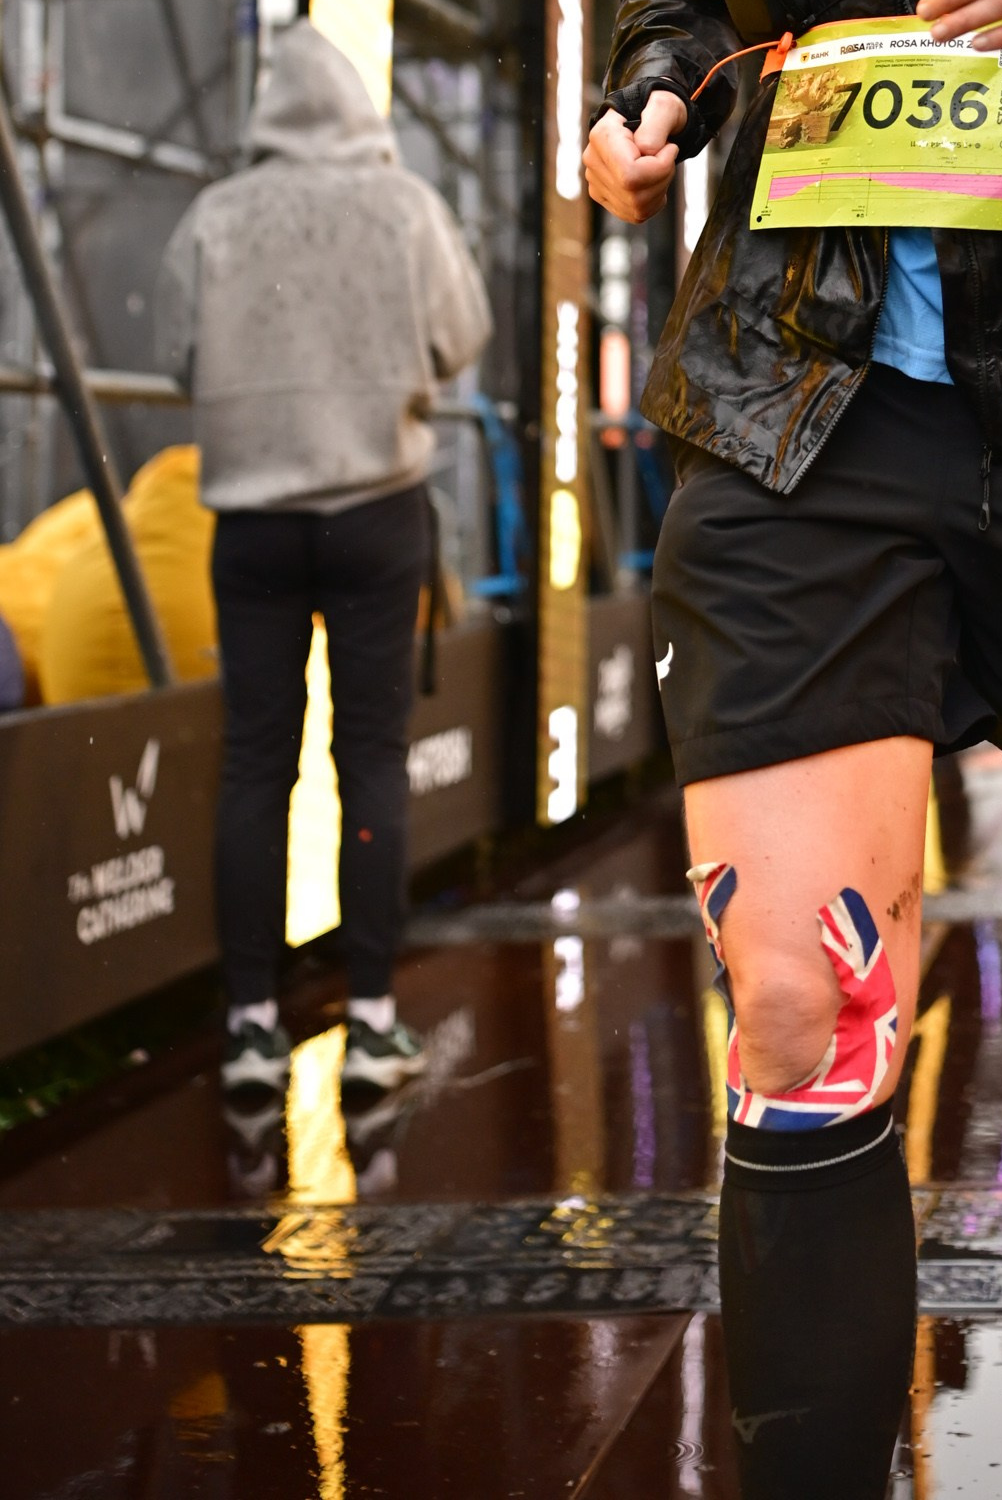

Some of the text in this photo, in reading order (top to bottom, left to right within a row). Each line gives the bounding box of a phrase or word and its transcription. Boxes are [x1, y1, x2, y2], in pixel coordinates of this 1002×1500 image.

[890, 39, 918, 48] ROSA
[811, 51, 829, 60] БАНК
[830, 80, 990, 132] 7036
